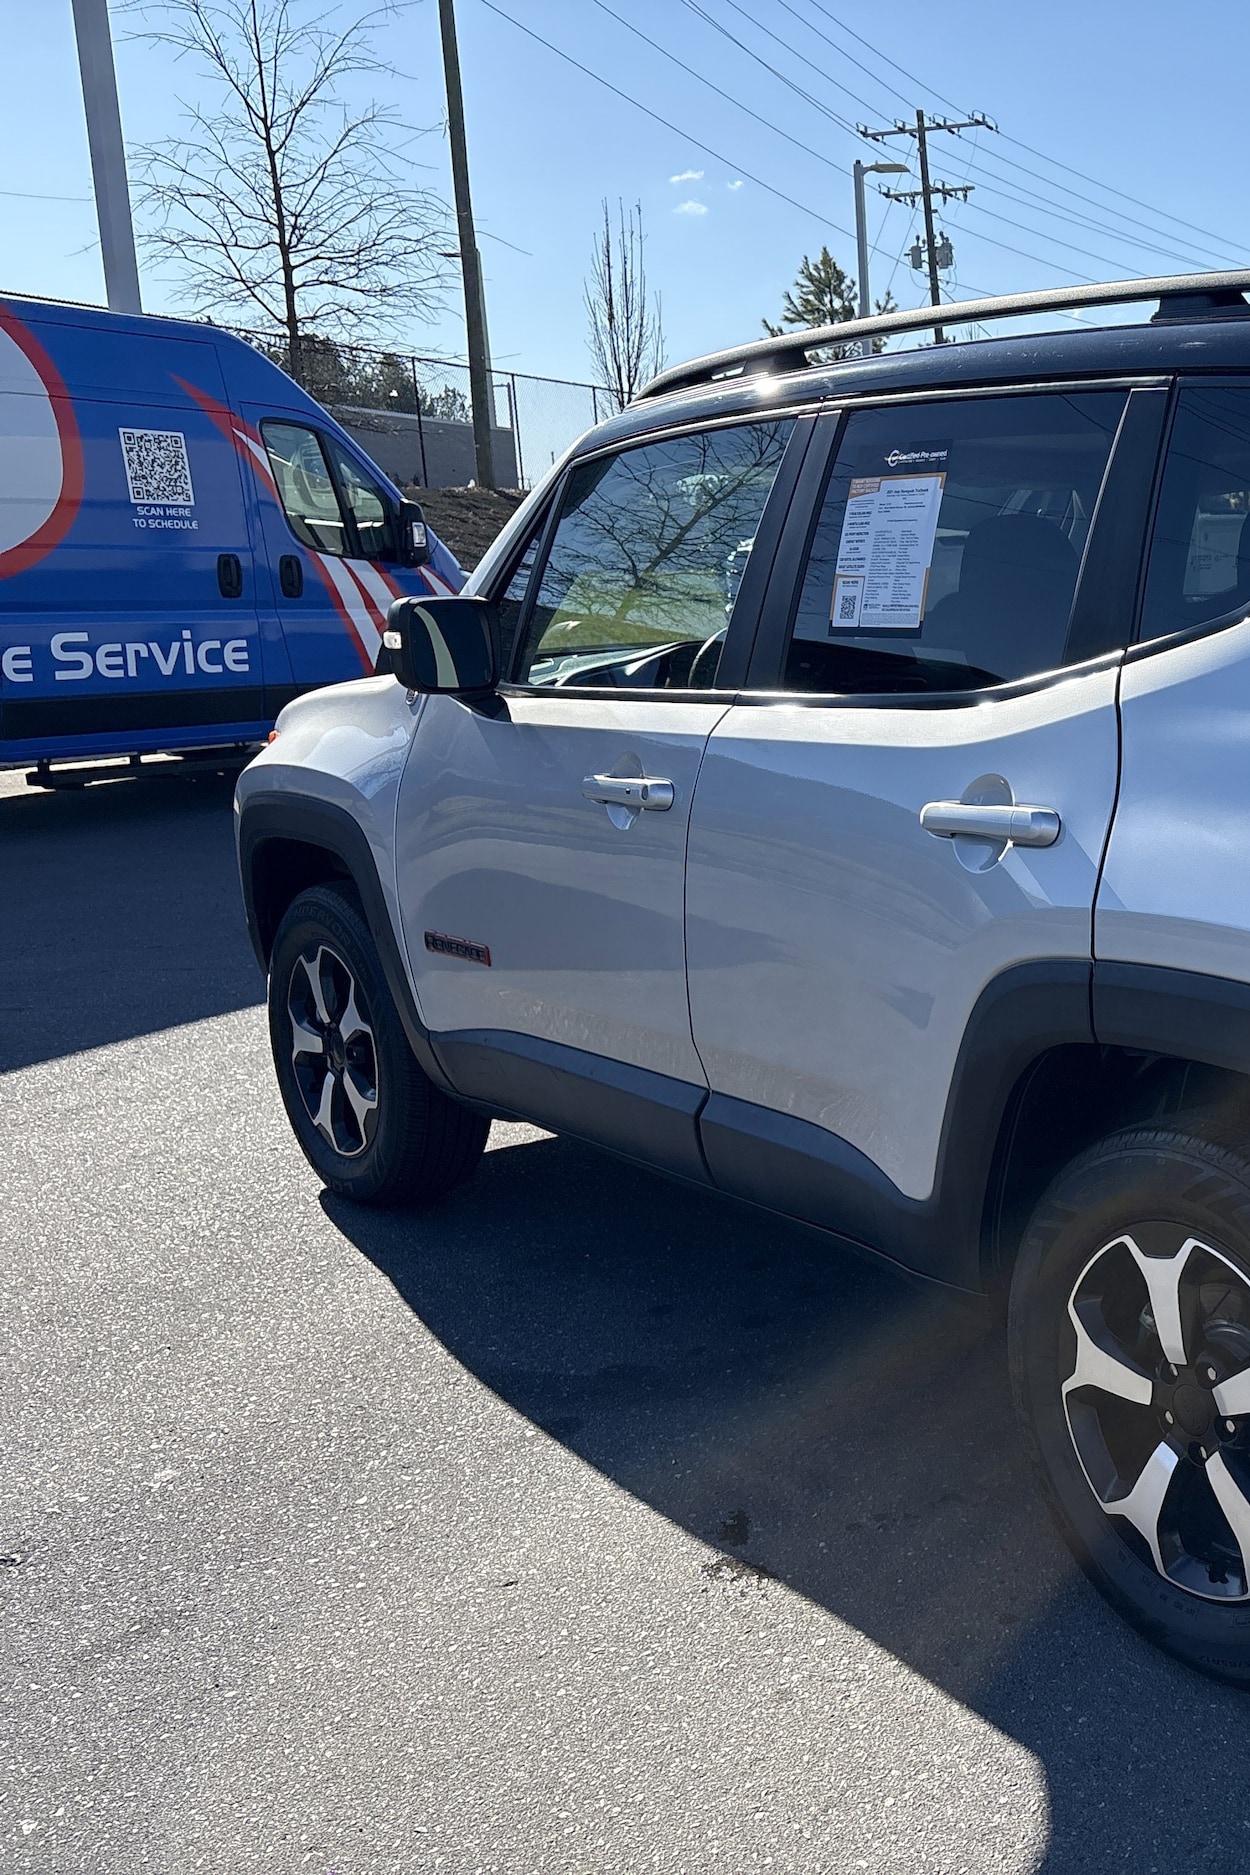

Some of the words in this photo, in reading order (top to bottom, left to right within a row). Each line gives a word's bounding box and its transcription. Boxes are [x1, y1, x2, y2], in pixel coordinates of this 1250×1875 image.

[132, 518, 147, 529] TO
[148, 519, 199, 530] SCHEDULE
[136, 506, 164, 517] SCAN
[165, 507, 192, 518] HERE
[50, 629, 250, 681] Service
[424, 930, 491, 967] RENEGADE
